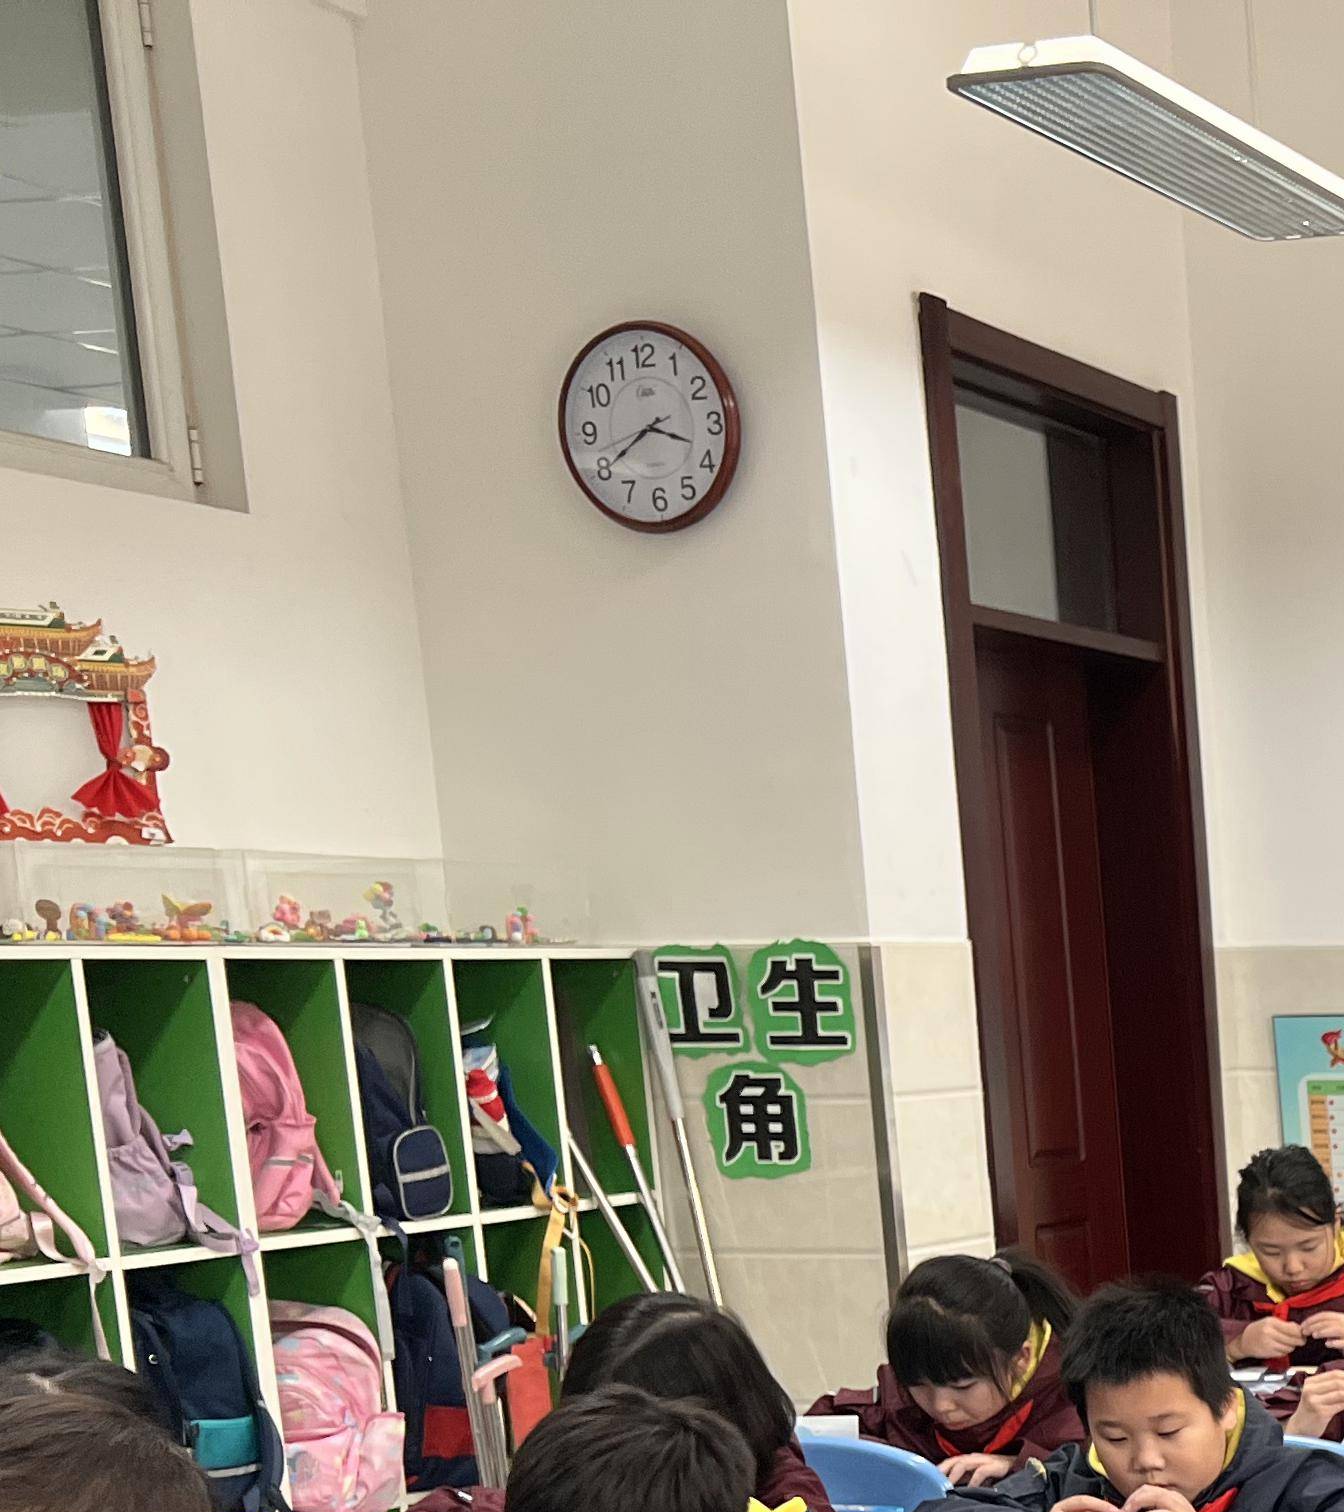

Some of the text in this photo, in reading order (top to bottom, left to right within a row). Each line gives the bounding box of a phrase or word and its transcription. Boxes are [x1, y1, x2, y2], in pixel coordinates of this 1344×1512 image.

[605, 356, 626, 381] 11
[631, 343, 656, 369] 12
[669, 352, 678, 376] 1
[587, 383, 611, 408] 10
[690, 376, 708, 401] 2
[582, 421, 597, 445] 9
[706, 411, 723, 435] 3
[597, 457, 612, 481] 8
[699, 449, 716, 474] 4
[621, 480, 636, 504] 7
[652, 487, 669, 512] 6
[680, 476, 696, 501] 5
[657, 957, 849, 1046] 卫生
[719, 1073, 799, 1162] 角
